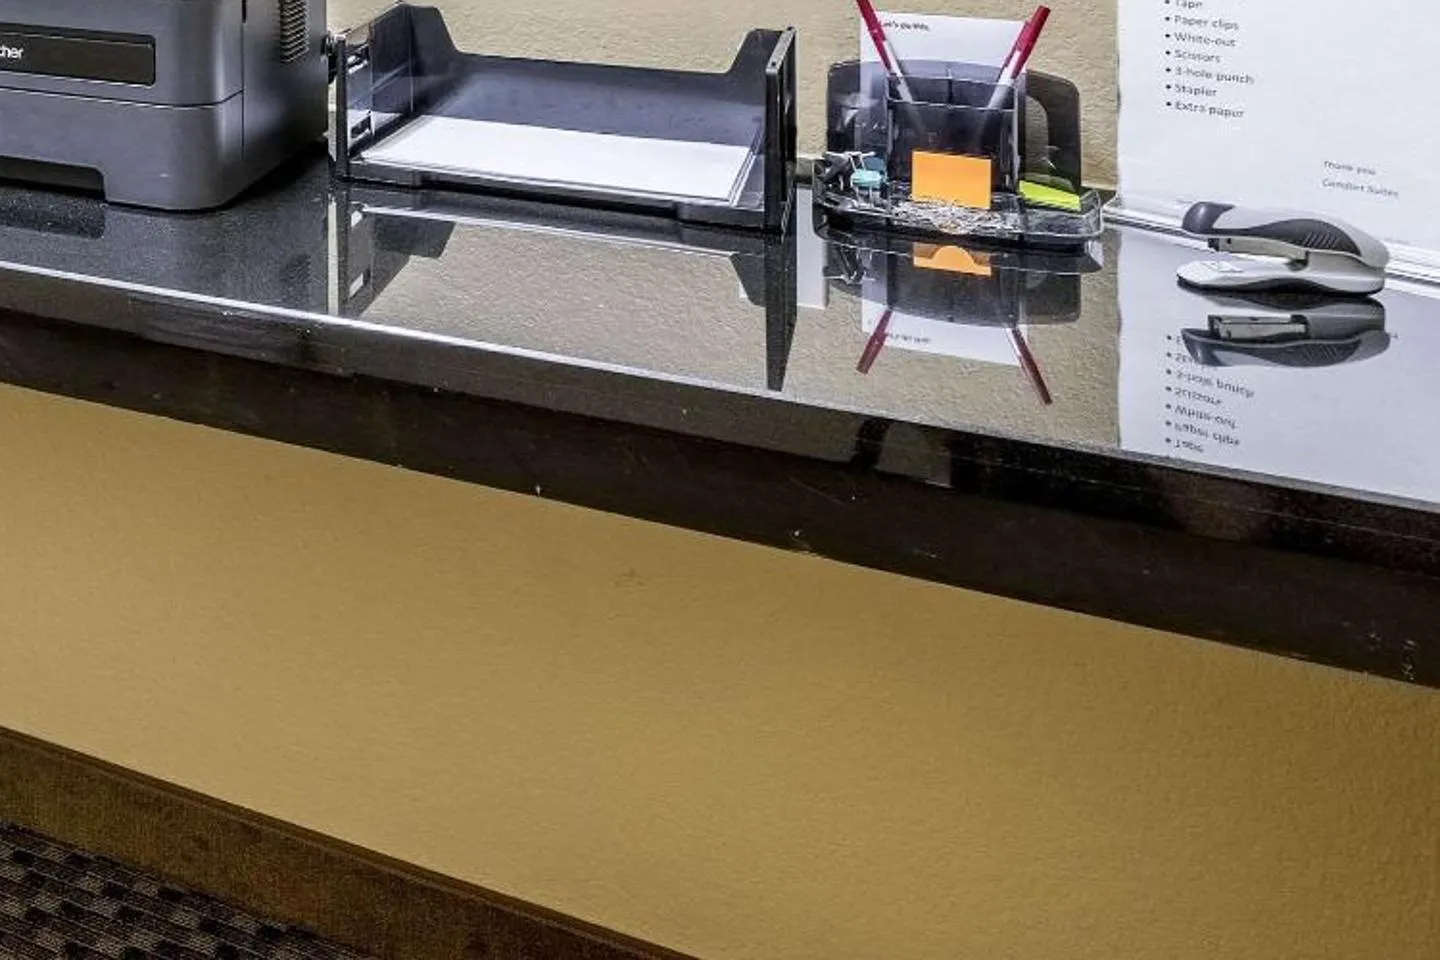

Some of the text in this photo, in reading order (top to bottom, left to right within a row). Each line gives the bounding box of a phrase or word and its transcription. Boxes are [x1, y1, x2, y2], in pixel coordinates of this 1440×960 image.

[1174, 14, 1239, 31] Paper clips
[1174, 31, 1236, 47] White-out
[1174, 49, 1221, 63] Scissors
[1216, 72, 1255, 85] punch
[1174, 83, 1218, 97] Stapler
[1175, 100, 1245, 119] Extra paper
